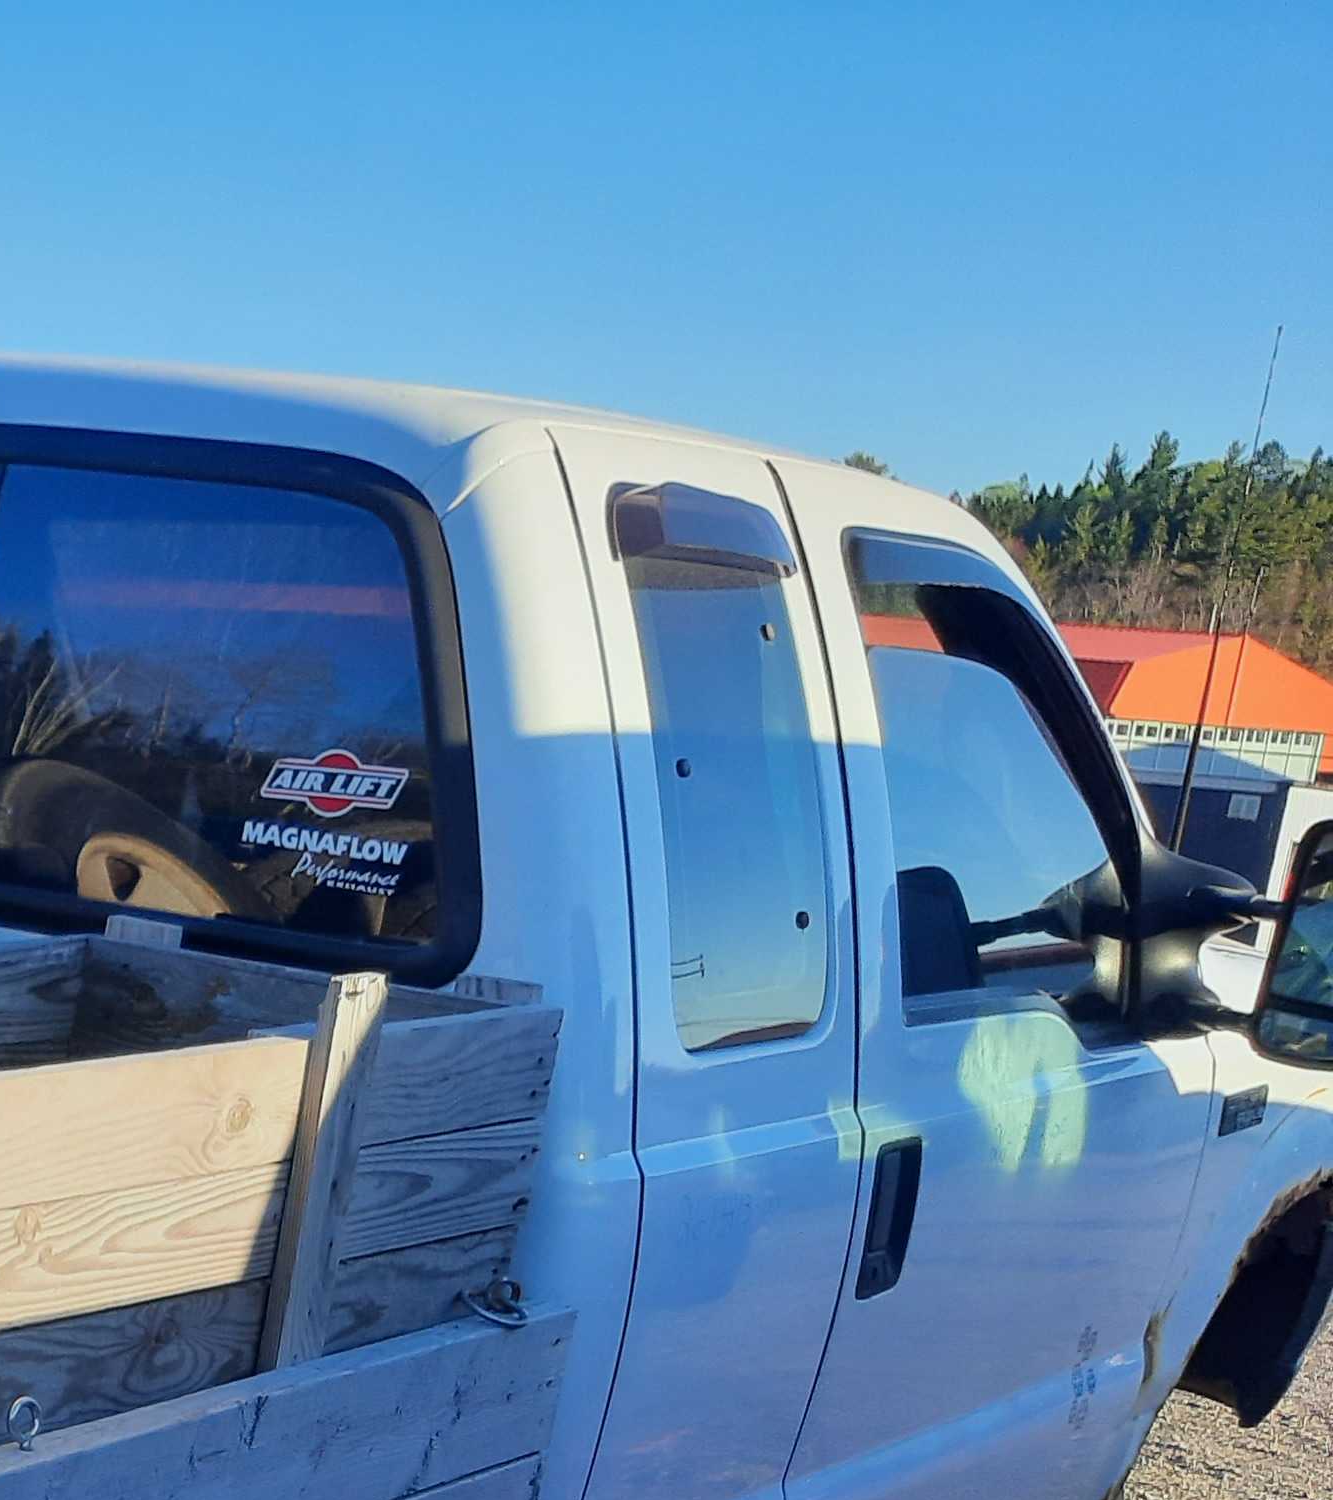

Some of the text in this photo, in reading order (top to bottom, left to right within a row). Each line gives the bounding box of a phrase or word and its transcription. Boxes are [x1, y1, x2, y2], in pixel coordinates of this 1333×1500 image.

[271, 769, 398, 798] AIR LIFT
[241, 820, 409, 866] MAGNAFLOW
[290, 851, 401, 887] Performance
